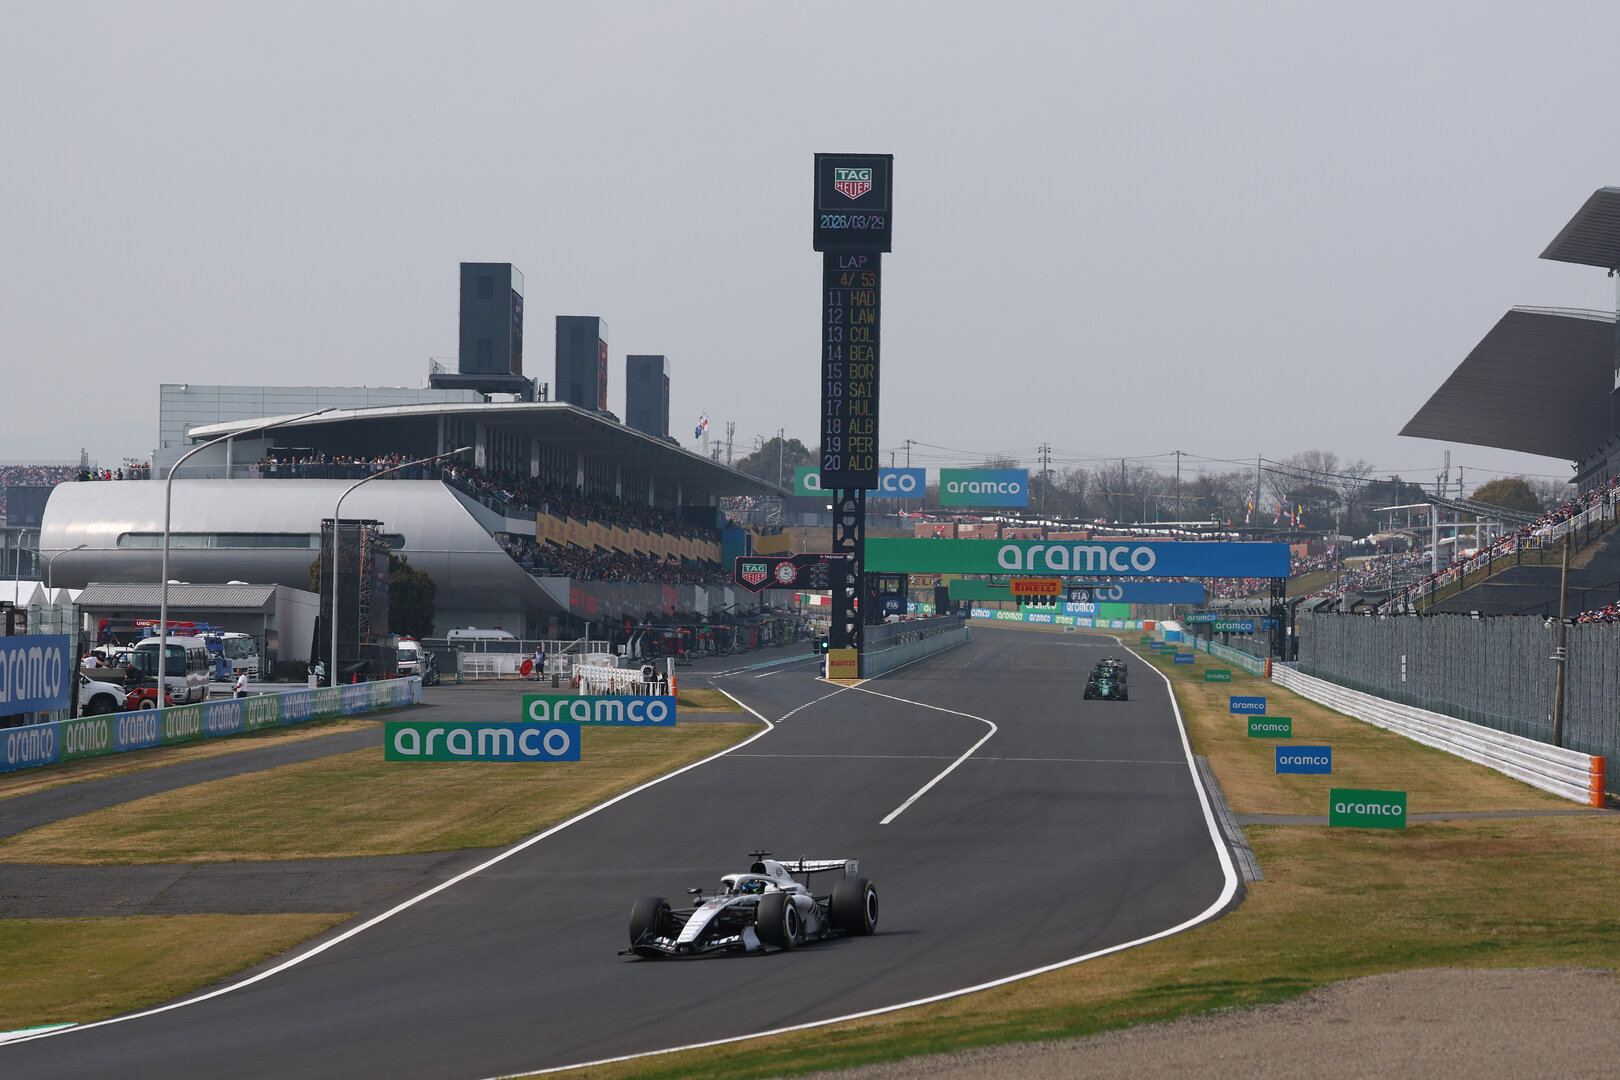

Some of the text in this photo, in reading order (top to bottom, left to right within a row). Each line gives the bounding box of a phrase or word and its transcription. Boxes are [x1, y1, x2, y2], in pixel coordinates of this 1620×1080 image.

[838, 170, 869, 180] TAG
[836, 182, 870, 197] HEUER
[821, 215, 885, 230] 2026/03/29
[839, 256, 867, 268] LAP
[861, 273, 876, 287] 53
[828, 291, 875, 306] 11 HAD
[827, 308, 875, 324] 12 LAW
[827, 327, 874, 343] 13 COL
[827, 345, 875, 361] 14 BEA
[827, 363, 874, 379] 15 BOR
[827, 381, 873, 398] 16 SAI
[826, 400, 873, 416] 17 HUL
[826, 418, 873, 434] 18 ALB
[826, 436, 873, 453] 19 PER
[824, 454, 873, 471] 20 ALO
[947, 481, 1020, 495] aramco
[997, 544, 1156, 572] aramco
[743, 573, 767, 584] HEUER
[1014, 581, 1057, 592] PIRELLI
[970, 609, 991, 618] amco
[997, 611, 1023, 621] aramco
[1187, 614, 1216, 622] aramco
[1215, 622, 1252, 630] aramco
[250, 697, 278, 725] aramco
[528, 699, 668, 722] aramco
[1232, 702, 1265, 710] aramco
[166, 707, 200, 738] aramco
[209, 702, 241, 731] aramco
[119, 713, 156, 745] aramco
[1250, 721, 1290, 732] aramco
[66, 719, 108, 754] aramco
[394, 728, 571, 756] aramco
[8, 728, 54, 764] aramco
[1279, 755, 1329, 766] aramco
[1335, 801, 1403, 817] aramco
